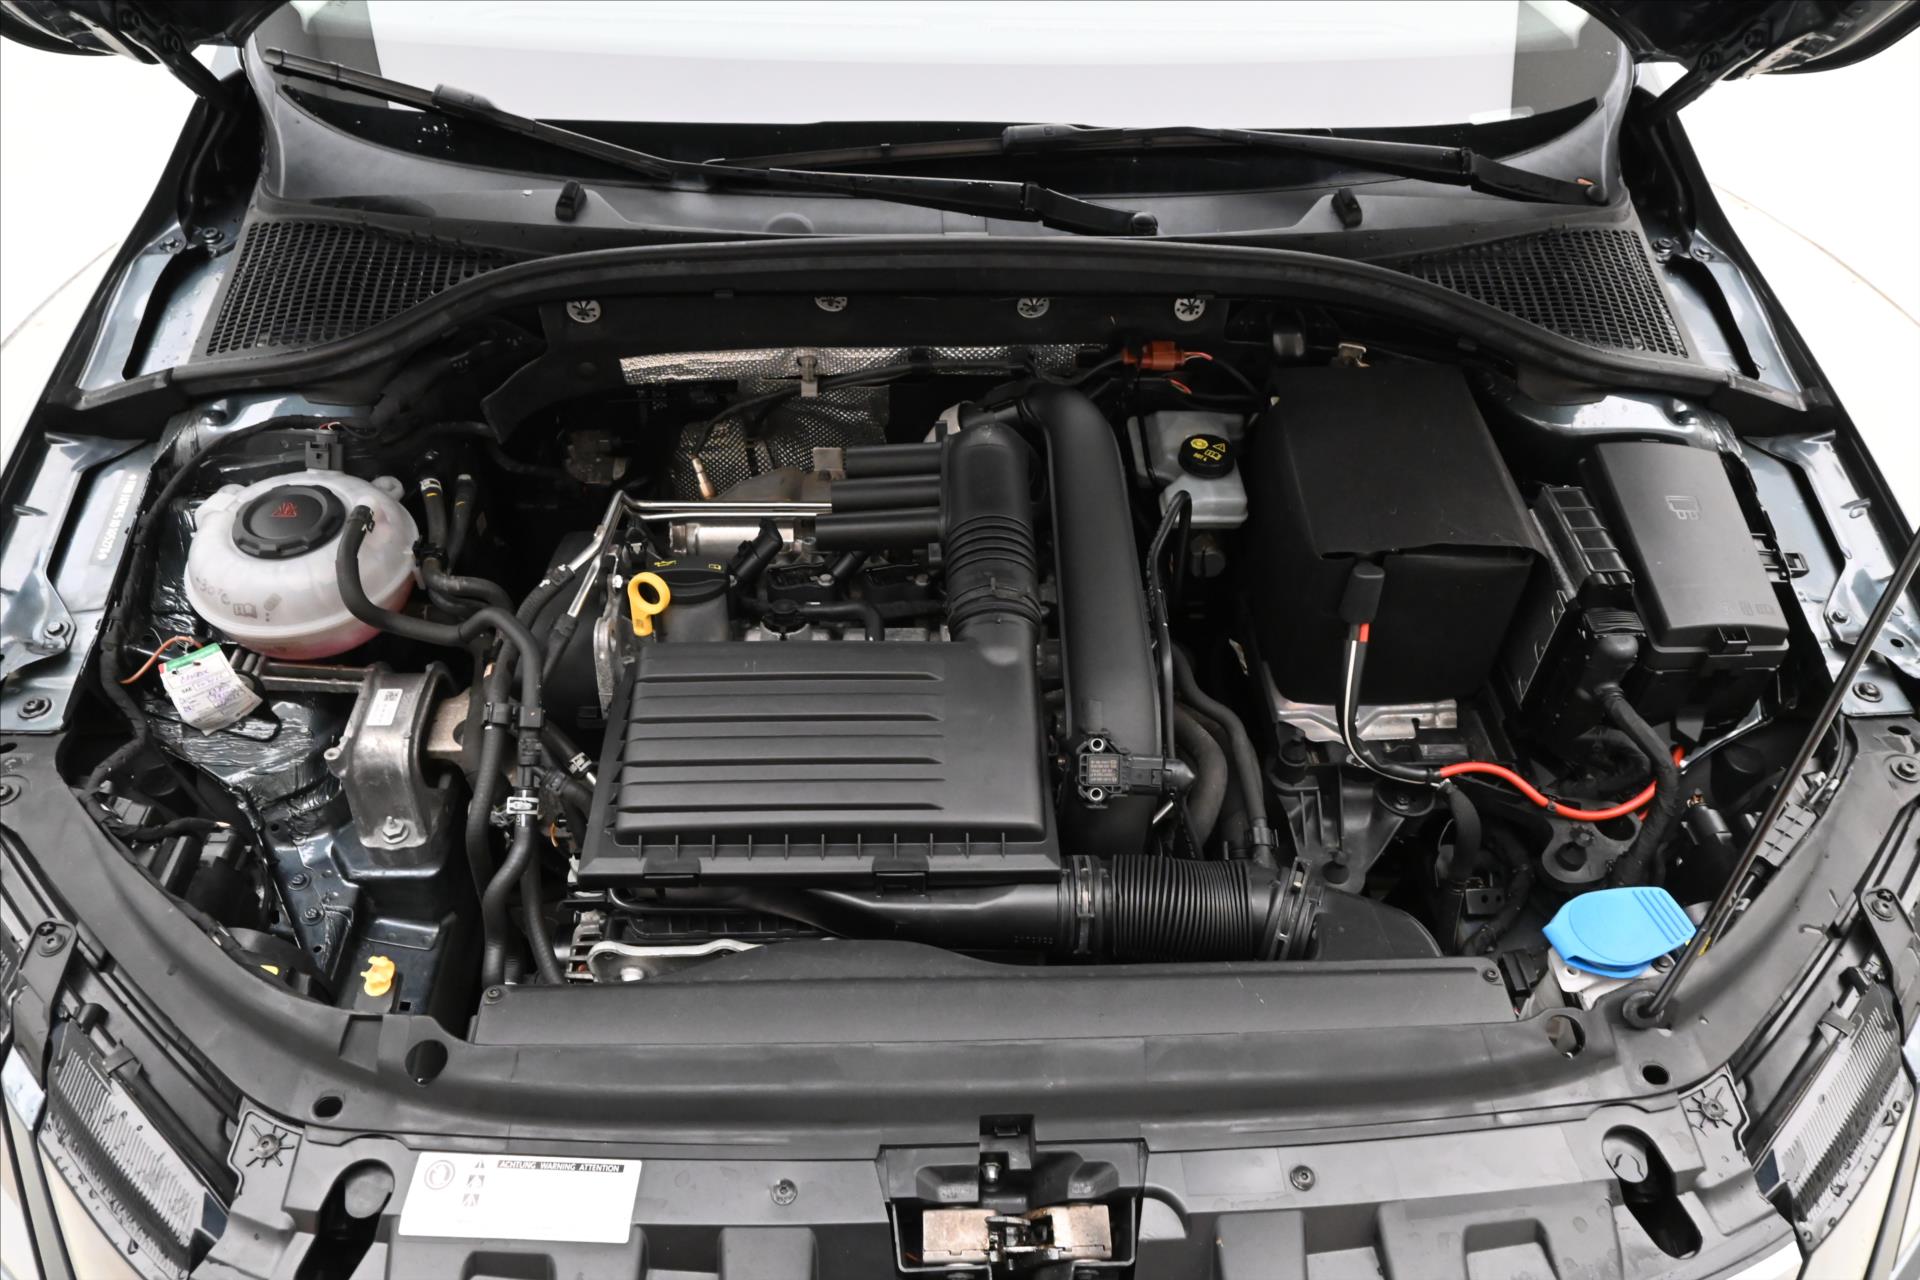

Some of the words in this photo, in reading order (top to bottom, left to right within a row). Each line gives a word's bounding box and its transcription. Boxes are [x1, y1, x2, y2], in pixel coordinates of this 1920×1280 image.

[500, 1161, 536, 1169] ACHTUNG
[540, 1162, 576, 1171] WARNING
[579, 1164, 620, 1172] ATTENTION
